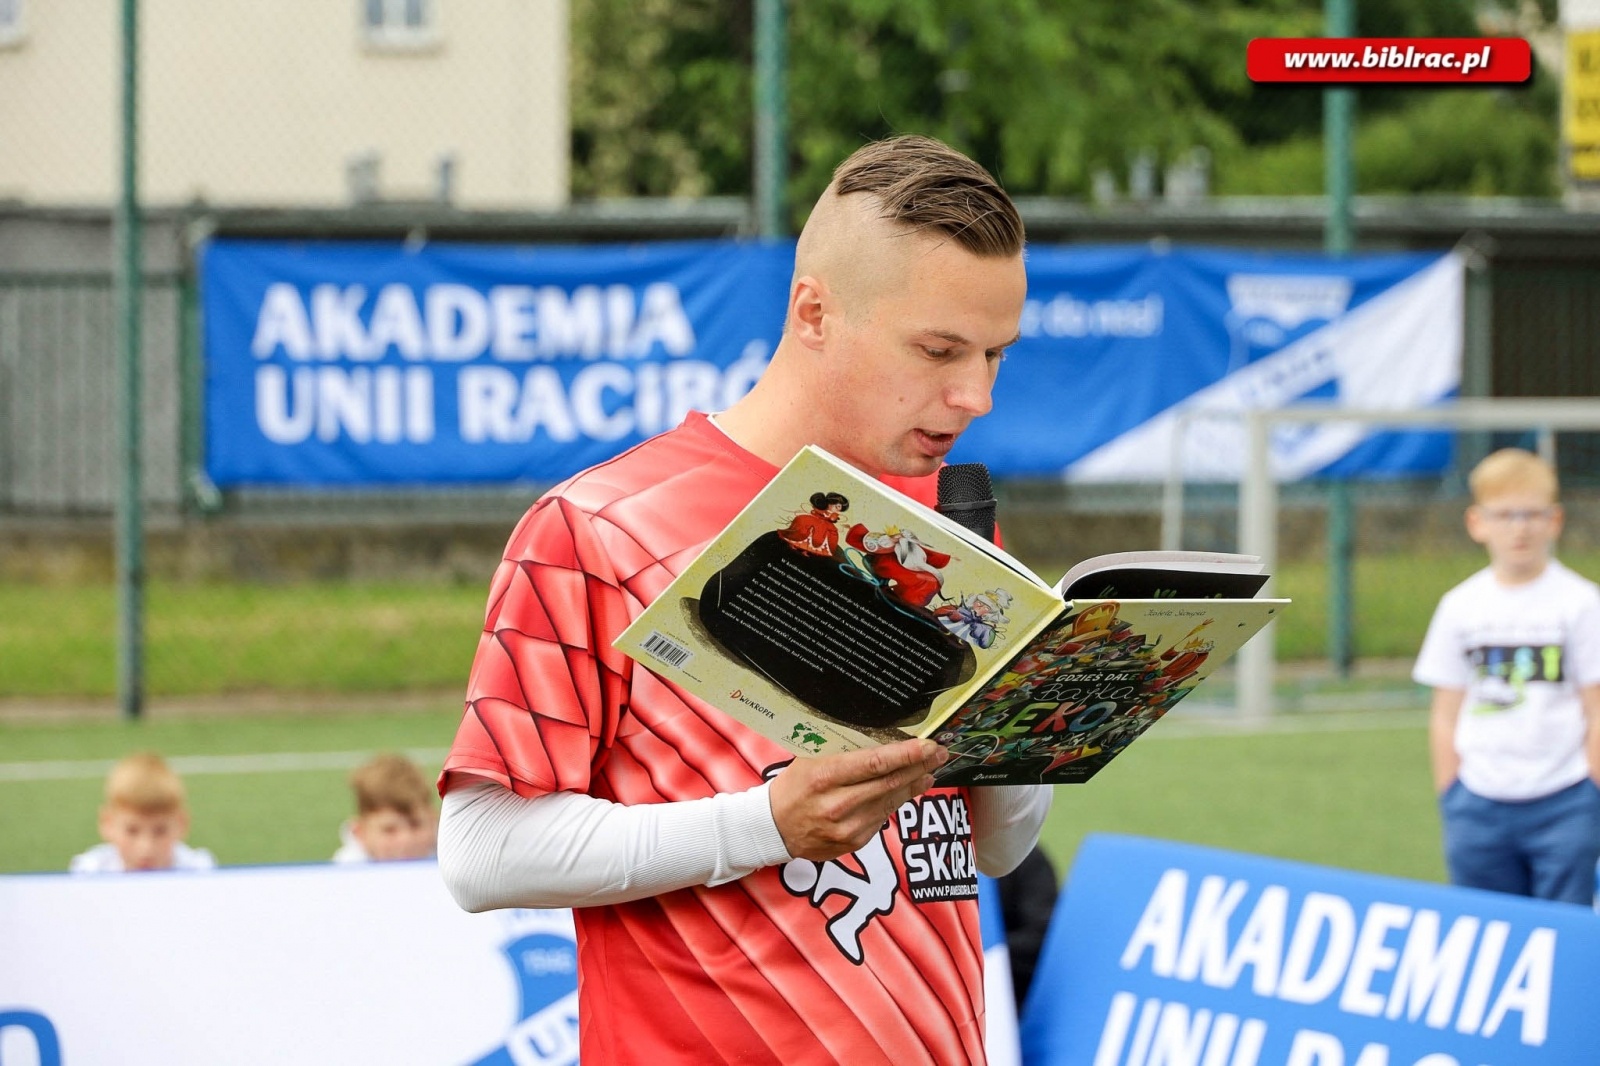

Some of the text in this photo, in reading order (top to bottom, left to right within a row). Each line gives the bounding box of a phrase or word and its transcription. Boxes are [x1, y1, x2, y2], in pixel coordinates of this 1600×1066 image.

[251, 281, 695, 363] AKADEMIA
[255, 363, 434, 445] UNII
[1001, 701, 1118, 734] EKO
[1034, 681, 1135, 716] Bajka
[897, 798, 972, 839] PAVEŁ
[904, 834, 979, 882] SKÓRA
[1119, 867, 1558, 1047] AKADEMIA
